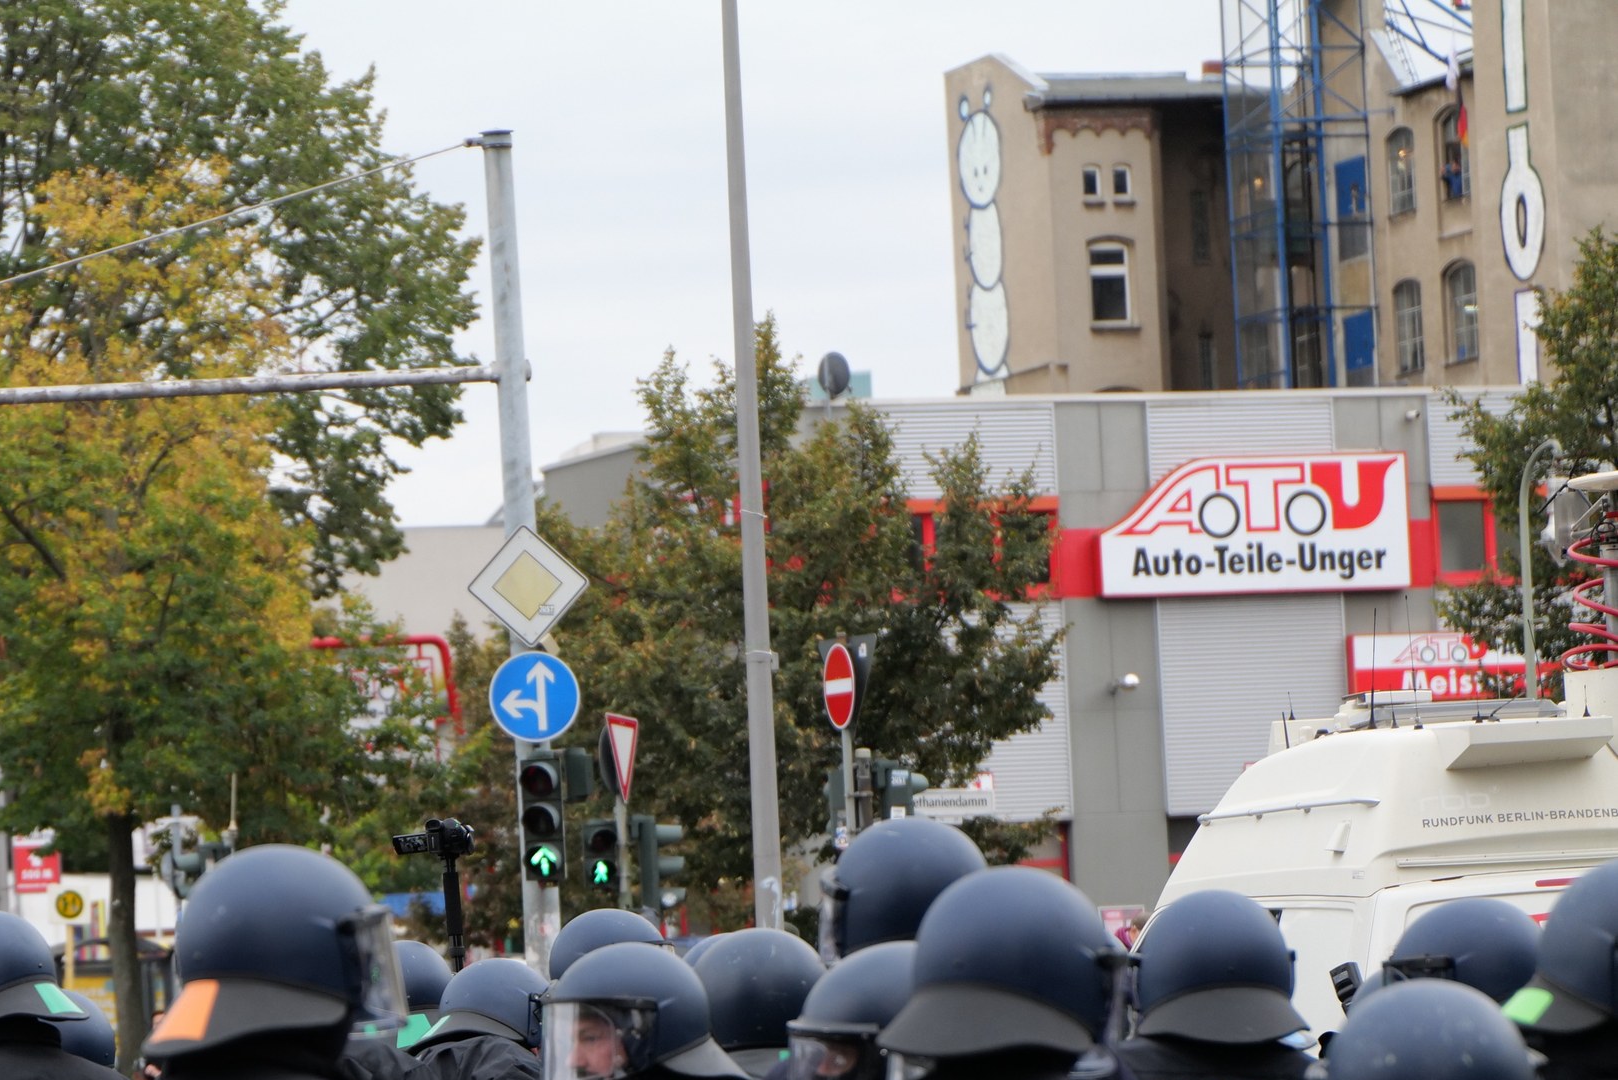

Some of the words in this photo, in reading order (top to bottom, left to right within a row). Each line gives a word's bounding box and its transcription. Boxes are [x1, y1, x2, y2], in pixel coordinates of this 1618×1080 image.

[1132, 542, 1386, 579] Auto-Teile-Unger
[914, 795, 988, 809] ethaniendamm
[1422, 813, 1494, 828] RUNDFUNK
